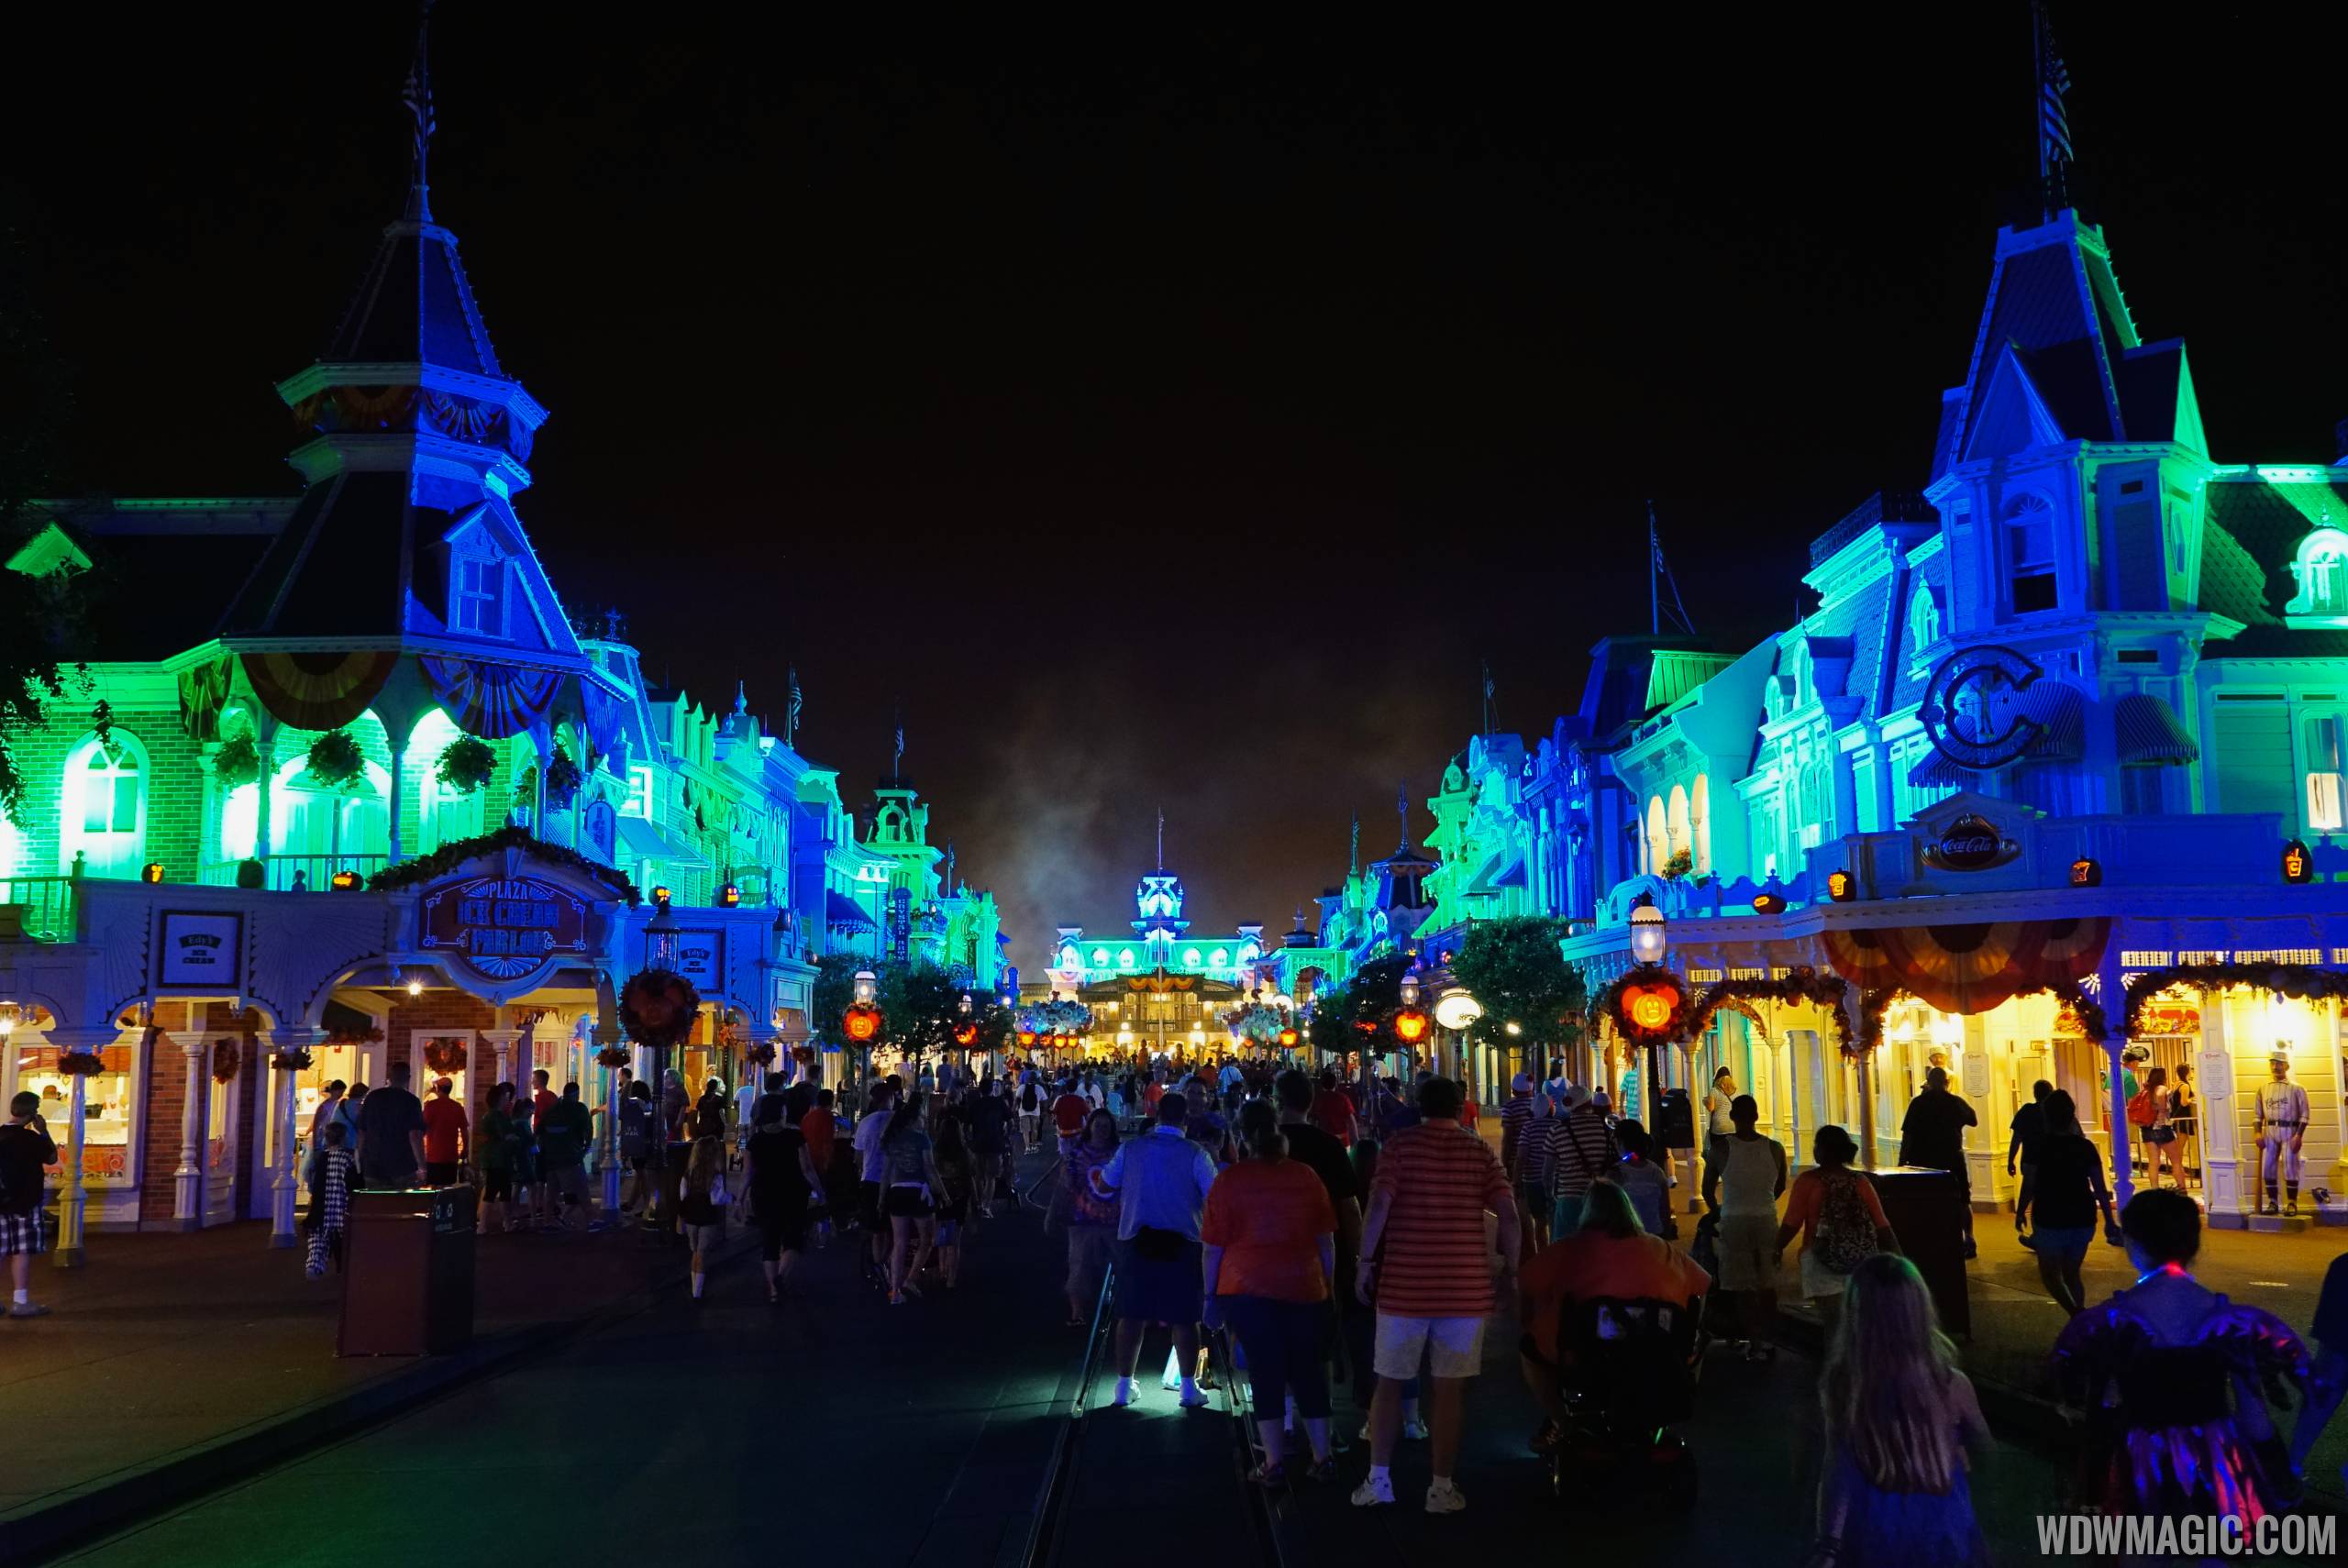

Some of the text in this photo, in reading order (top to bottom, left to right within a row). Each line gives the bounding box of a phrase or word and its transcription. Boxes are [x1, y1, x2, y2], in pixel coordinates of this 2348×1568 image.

[1943, 835, 1991, 855] Coca-Cola
[488, 880, 528, 900] PLAZA
[459, 900, 559, 928] ICE CREAM
